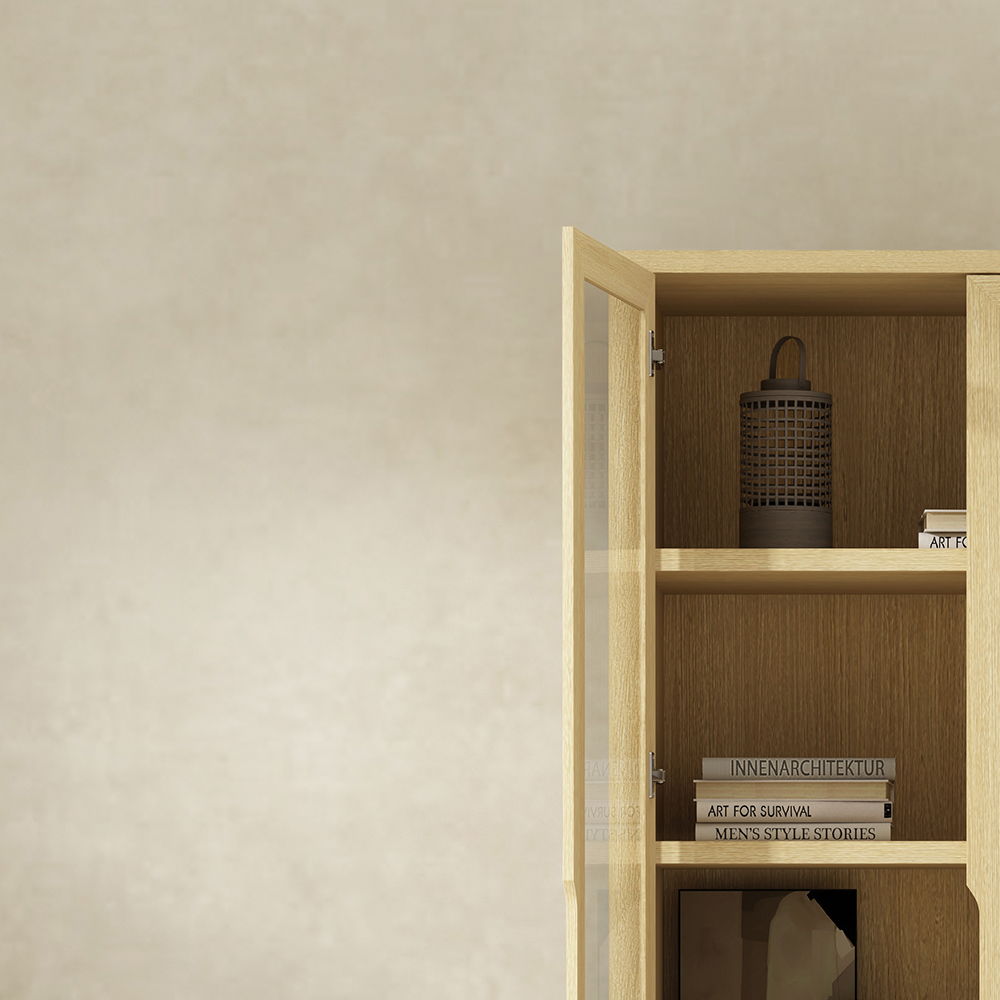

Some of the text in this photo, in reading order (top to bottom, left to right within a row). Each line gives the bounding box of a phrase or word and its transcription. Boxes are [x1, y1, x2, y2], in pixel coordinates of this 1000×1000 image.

[930, 536, 952, 549] ART
[730, 759, 886, 777] INNENARCHITEKTUR
[707, 804, 812, 818] ART FOR SURVIVAL
[715, 827, 877, 841] MEN'S STYLE STORIES
